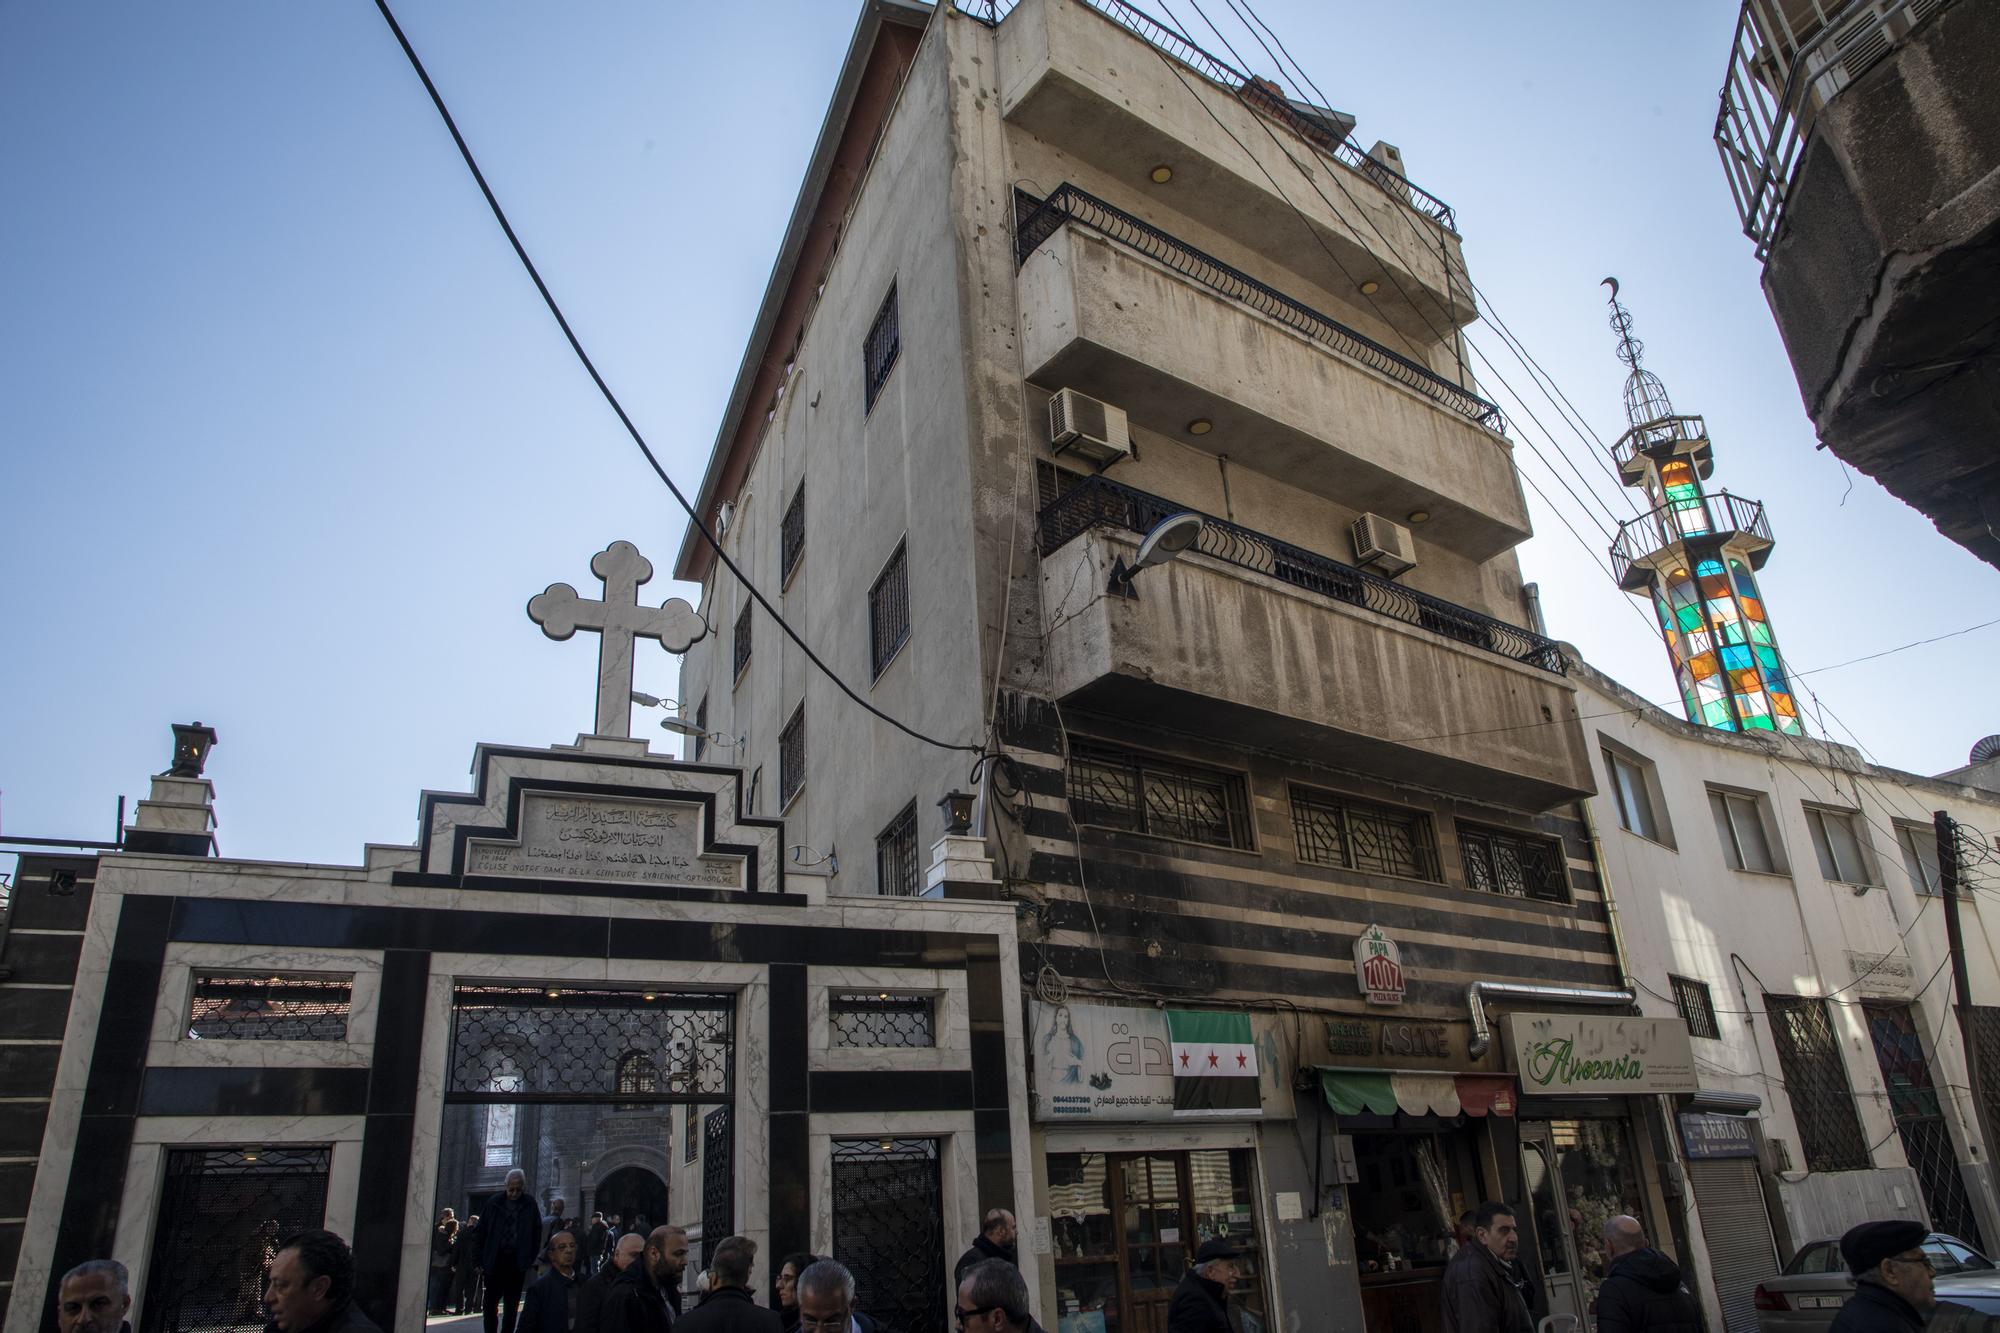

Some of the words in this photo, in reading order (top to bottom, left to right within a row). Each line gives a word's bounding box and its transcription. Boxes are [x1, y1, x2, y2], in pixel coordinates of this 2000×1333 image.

[1368, 941, 1389, 957] PAPA
[1365, 959, 1402, 991] ZOOZ
[1381, 1023, 1395, 1052] A
[1700, 1119, 1748, 1140] BEBLOS
